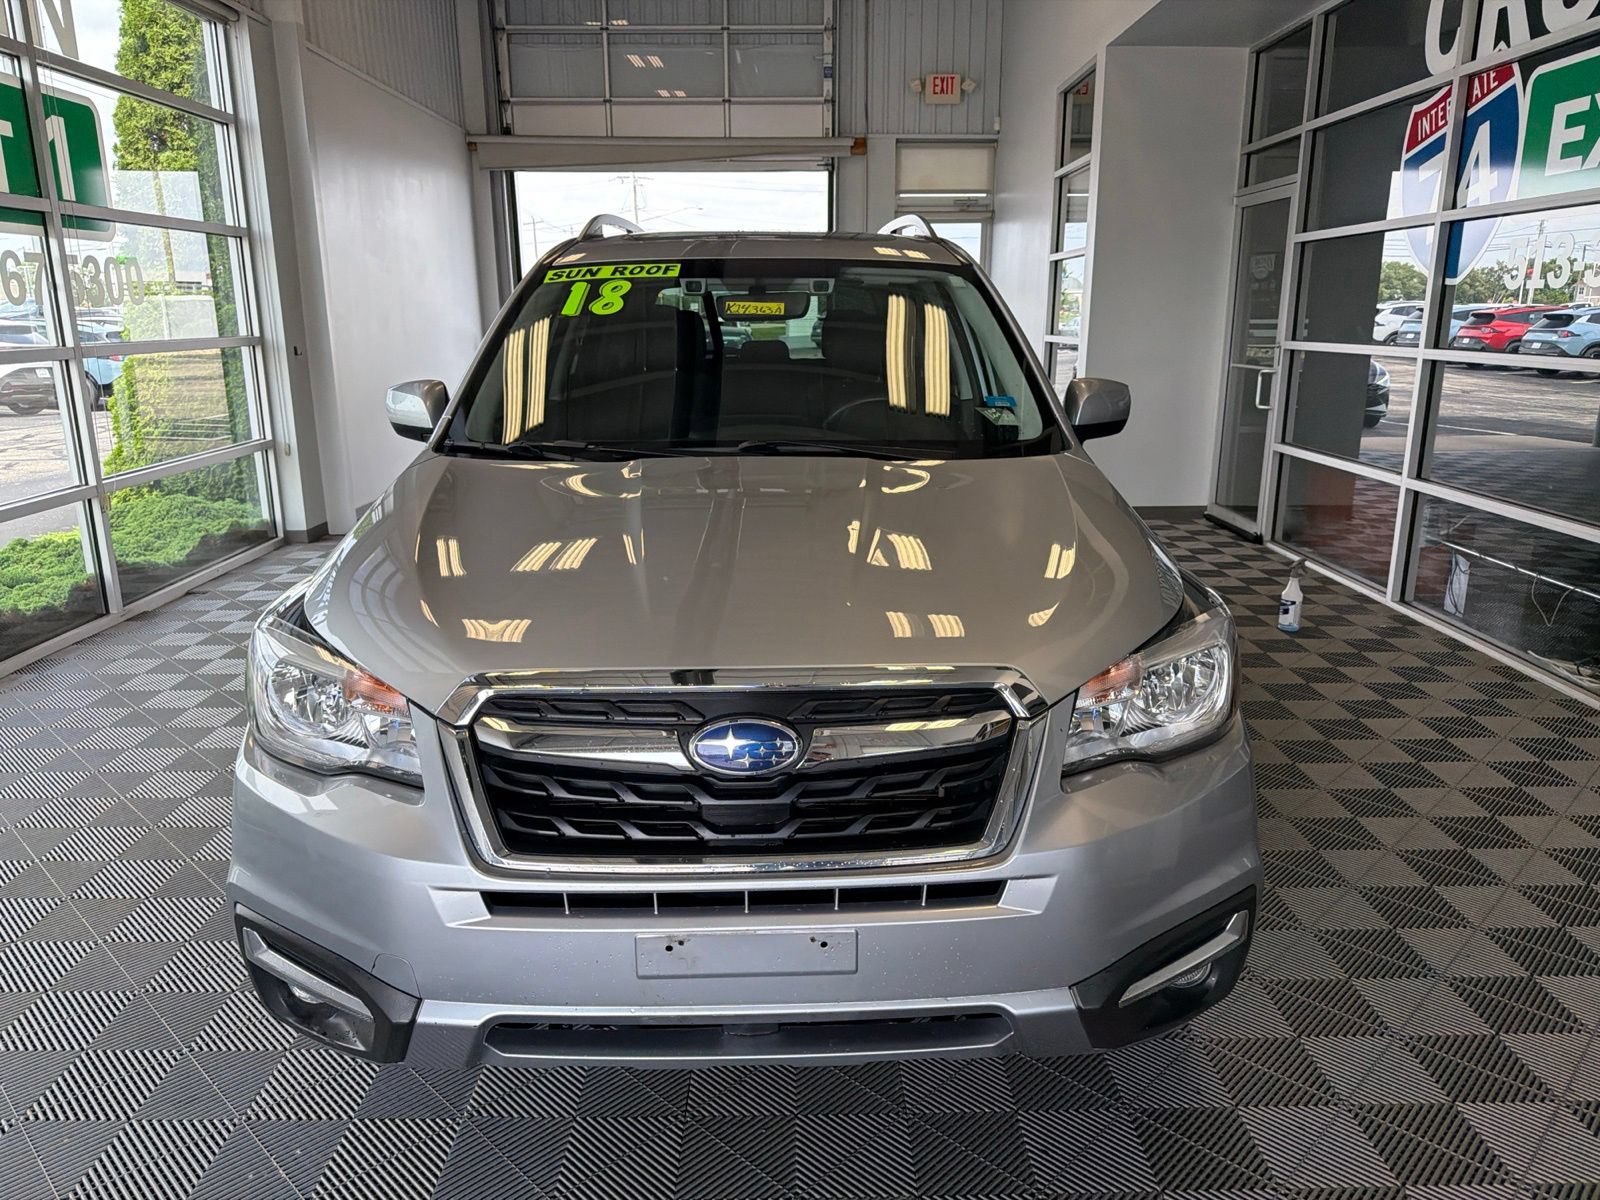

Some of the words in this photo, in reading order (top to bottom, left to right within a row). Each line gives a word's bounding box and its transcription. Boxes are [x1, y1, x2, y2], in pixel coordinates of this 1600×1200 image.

[932, 76, 955, 95] EXIT
[1417, 70, 1499, 141] INTERATE
[548, 267, 602, 281] SUN
[611, 264, 679, 277] ROOF
[561, 279, 632, 316] 18
